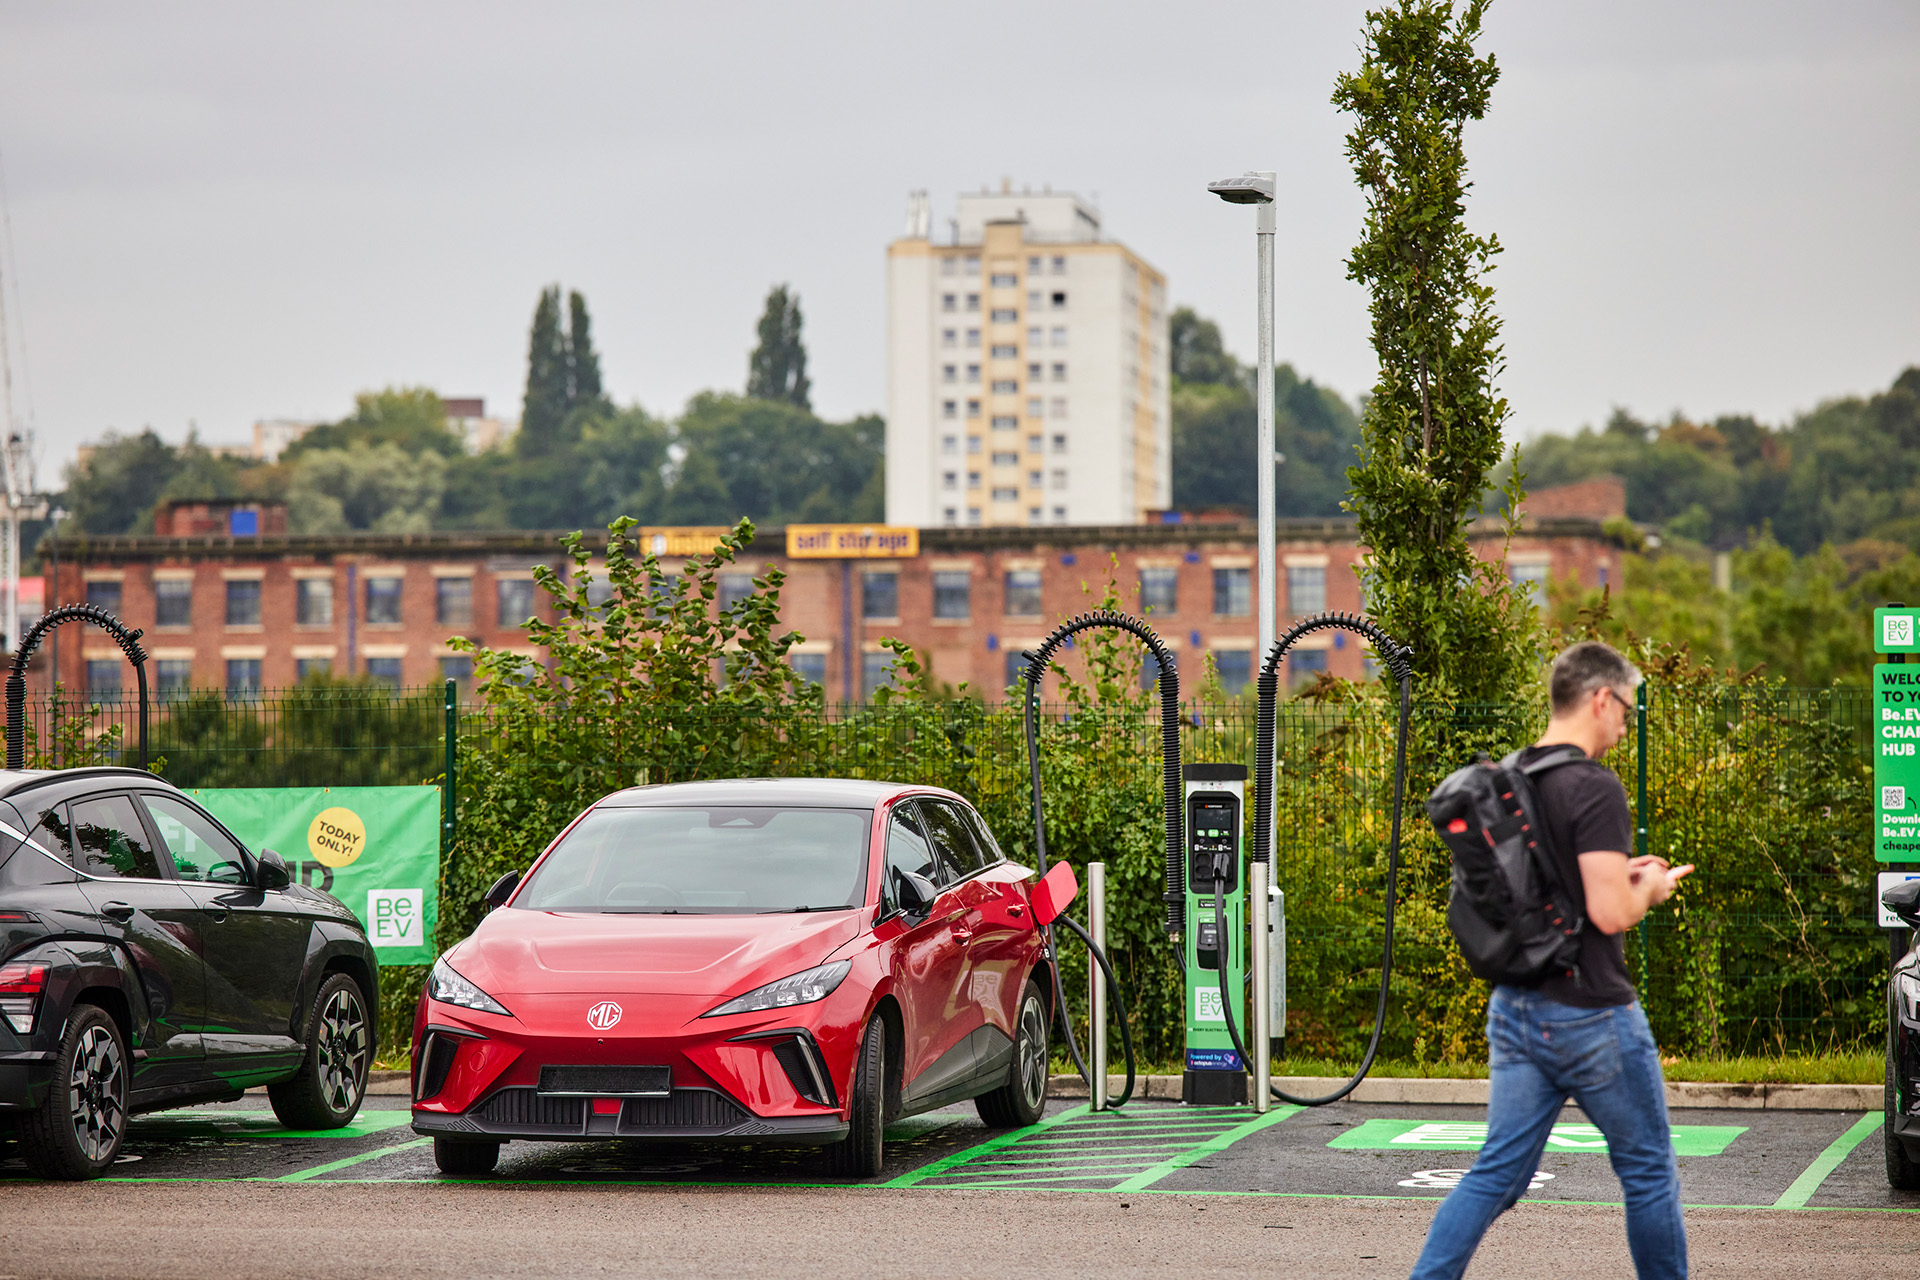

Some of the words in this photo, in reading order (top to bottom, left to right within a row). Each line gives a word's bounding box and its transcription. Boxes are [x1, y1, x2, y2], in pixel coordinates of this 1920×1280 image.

[1888, 620, 1909, 630] Be.
[1888, 631, 1908, 640] EV
[1882, 691, 1904, 702] TO
[1907, 691, 1920, 702] Y
[1882, 743, 1915, 756] HUB
[1883, 813, 1920, 824] Downl
[320, 821, 360, 844] TODAY
[1882, 827, 1915, 837] Be.EV
[317, 836, 353, 857] ONLY!
[376, 897, 415, 917] Be.
[376, 919, 412, 937] EV
[590, 1003, 620, 1027] MG
[1200, 1004, 1222, 1016] EV
